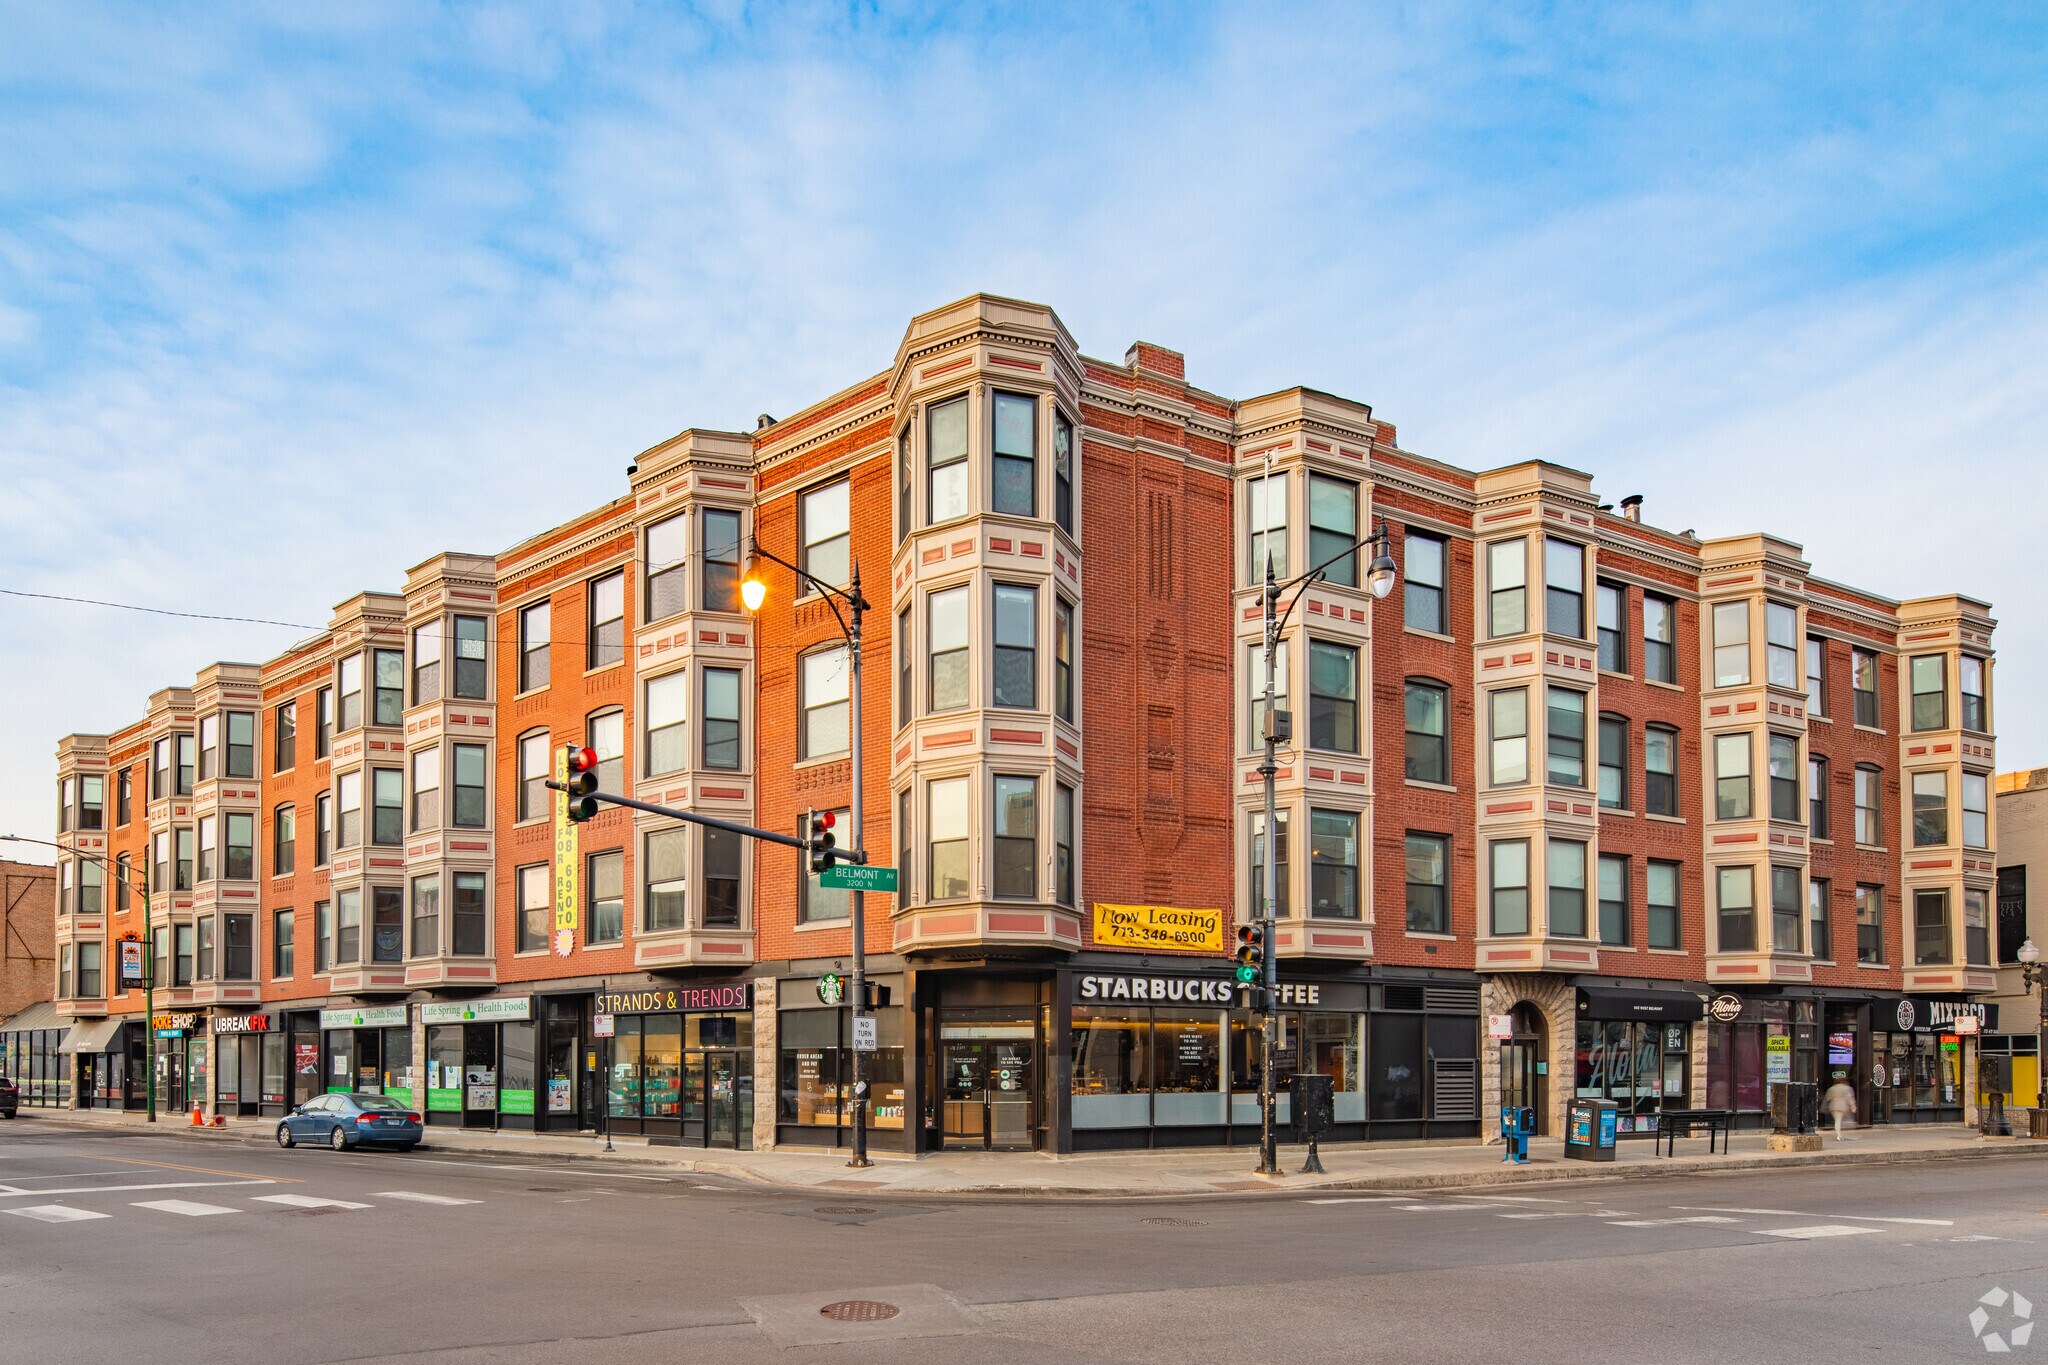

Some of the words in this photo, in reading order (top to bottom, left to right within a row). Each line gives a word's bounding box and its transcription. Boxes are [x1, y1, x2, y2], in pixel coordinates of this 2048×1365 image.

[836, 867, 879, 880] BELMONT
[846, 879, 863, 887] 3200
[1101, 909, 1139, 924] Now
[1149, 909, 1216, 933] Leasing
[1111, 925, 1206, 943] 773-348-6900
[1080, 976, 1232, 1001] STARBUCKS
[597, 992, 661, 1013] STRANDS
[667, 991, 677, 1009] &
[682, 987, 744, 1008] TRENDS
[1710, 1000, 1743, 1013] Aloha
[322, 1012, 334, 1021] Life
[334, 1012, 352, 1022] Spring
[365, 1009, 386, 1019] Health
[386, 1008, 405, 1018] Foods
[424, 1006, 437, 1016] Life
[438, 1005, 461, 1017] Spring
[477, 1002, 502, 1013] Health
[504, 1001, 528, 1011] Foods
[172, 1013, 194, 1028] SHOP
